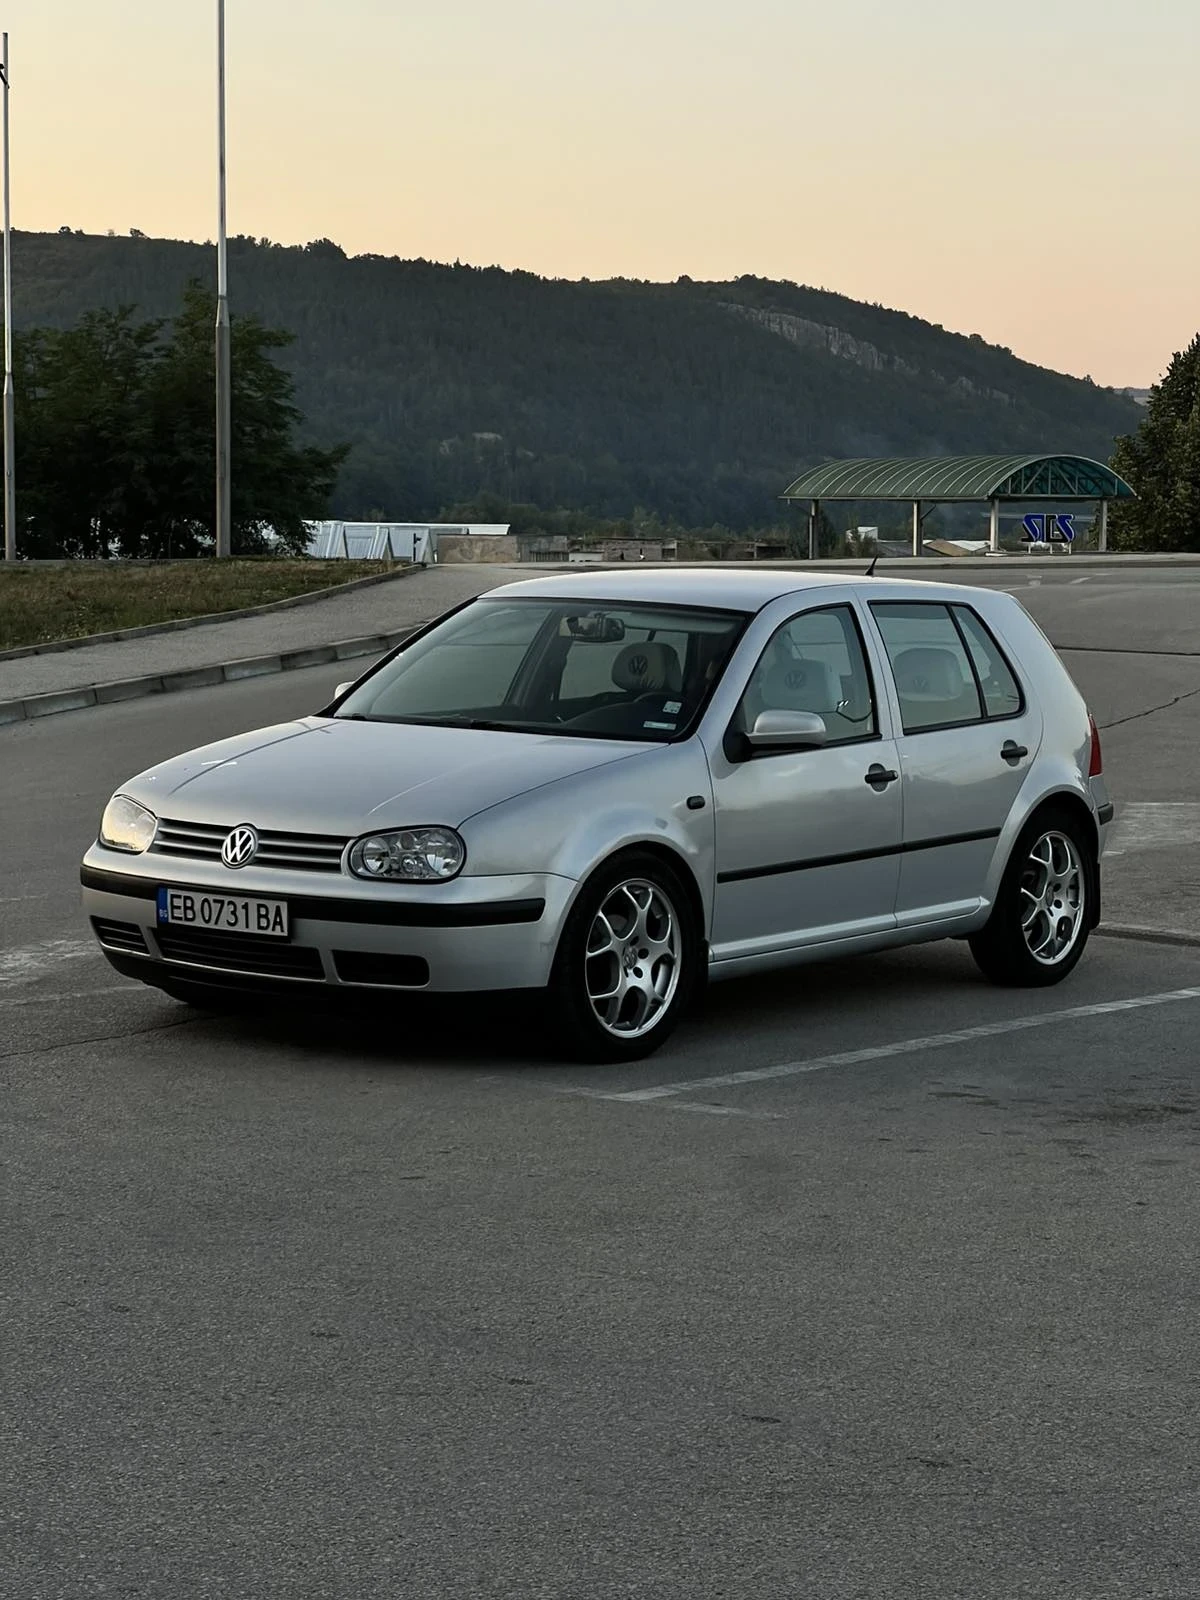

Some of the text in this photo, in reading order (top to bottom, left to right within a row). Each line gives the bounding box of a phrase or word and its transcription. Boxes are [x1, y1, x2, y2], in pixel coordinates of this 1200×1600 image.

[222, 827, 256, 867] VW
[170, 893, 285, 933] EB 0731 BA
